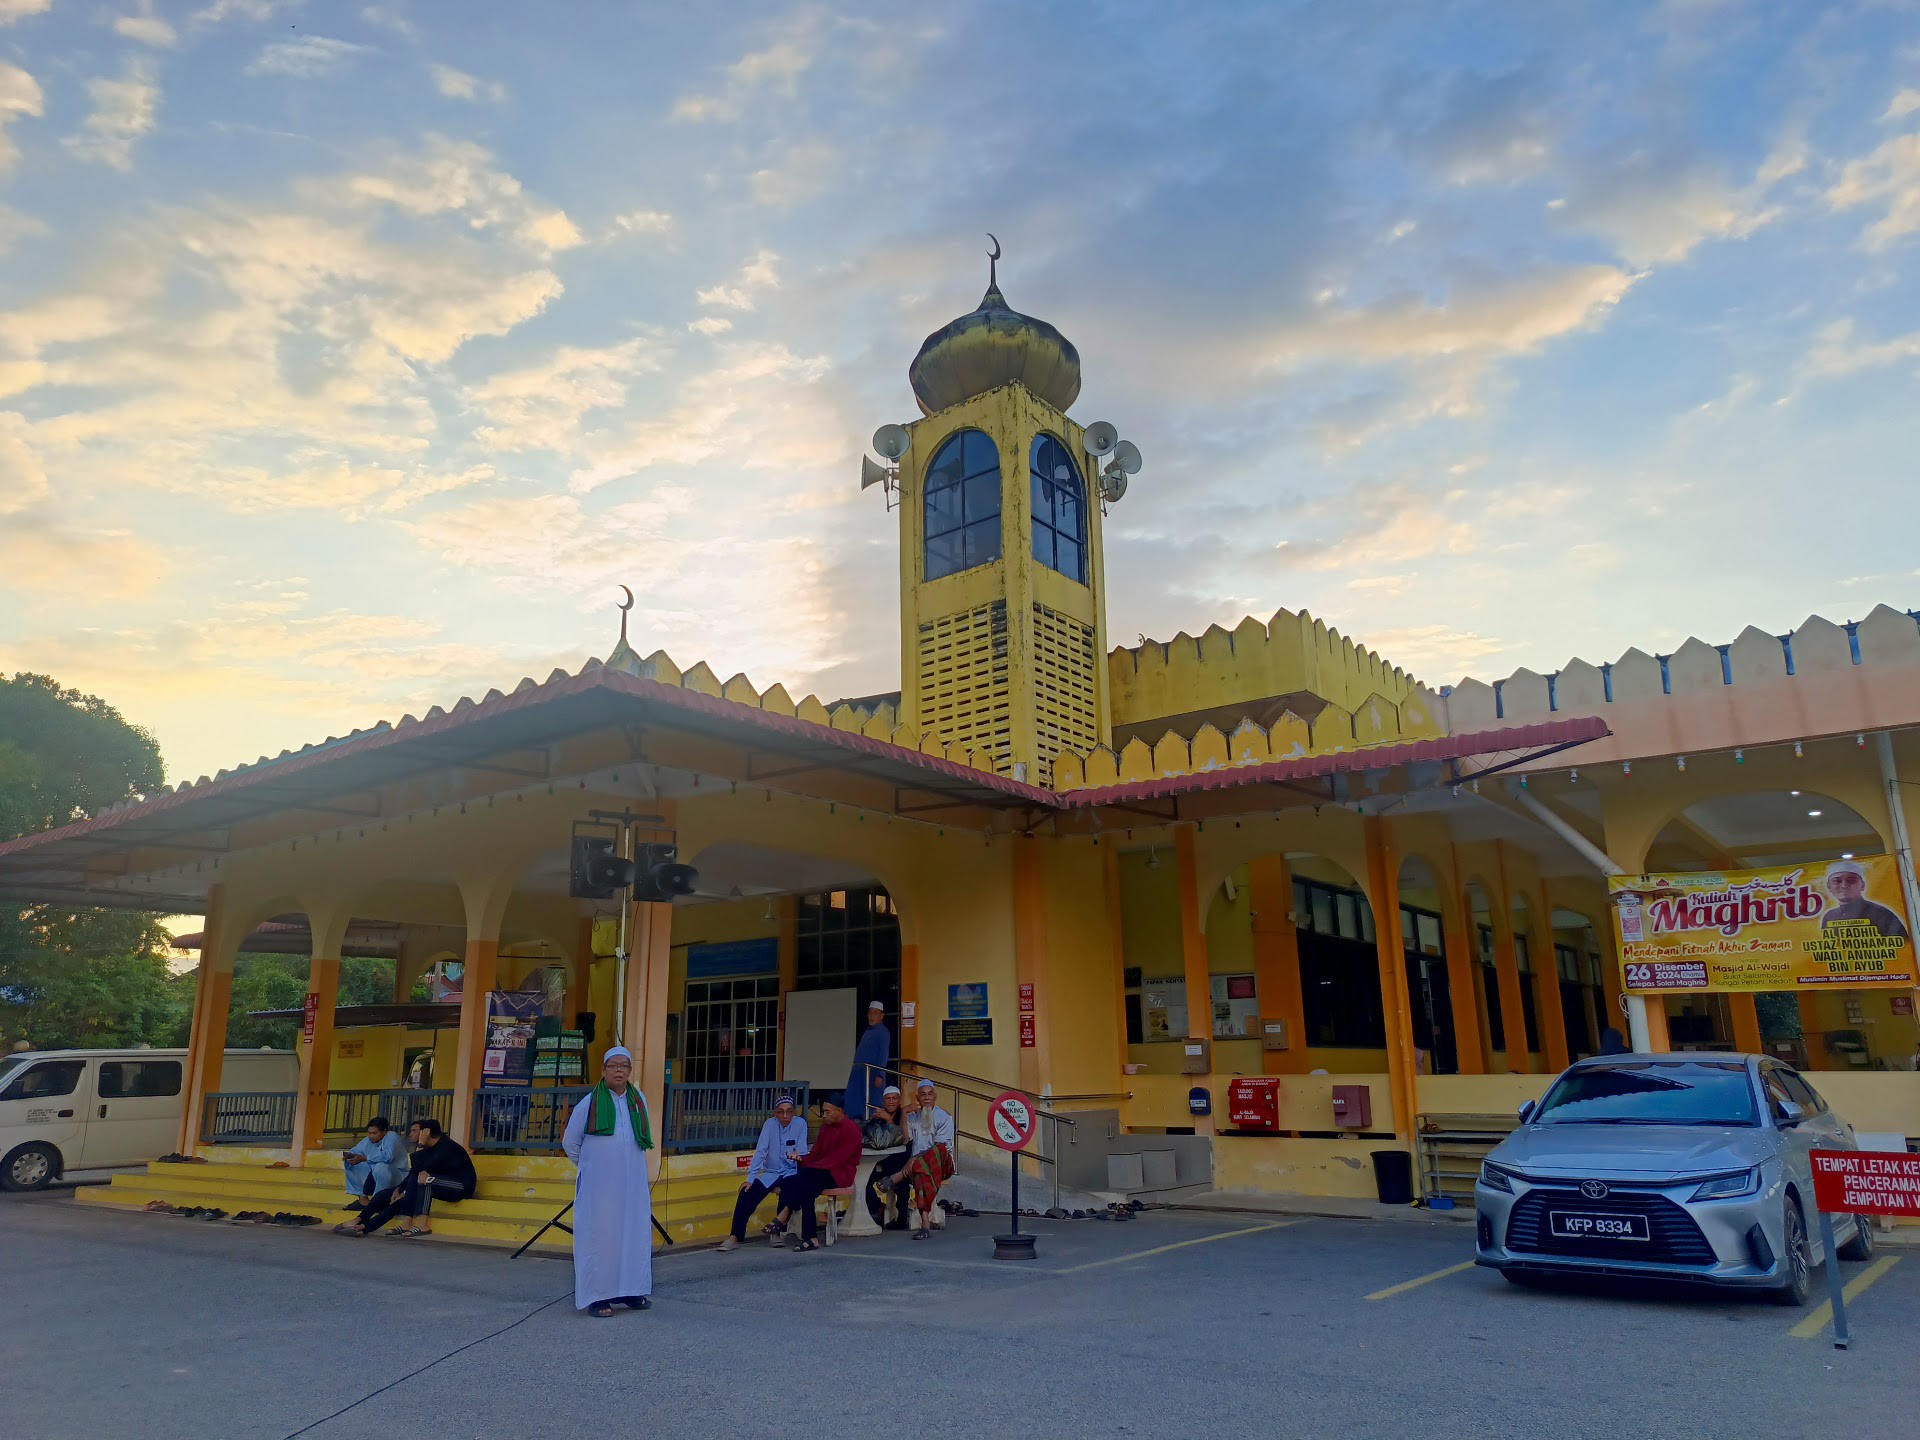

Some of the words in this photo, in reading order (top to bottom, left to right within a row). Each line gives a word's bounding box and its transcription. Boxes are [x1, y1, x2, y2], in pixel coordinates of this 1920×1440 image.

[1689, 891, 1737, 905] Kuliah
[1649, 886, 1822, 935] Maghrib
[1823, 929, 1835, 940] AL
[1840, 927, 1879, 939] FADHIL
[1624, 945, 1679, 958] Mendepani
[1682, 942, 1715, 955] Fitnah
[1719, 940, 1746, 952] Akhir
[1750, 939, 1790, 950] Zaman
[1802, 941, 1837, 952] USTAZ
[1841, 937, 1904, 950] MOHAMAD
[1813, 951, 1842, 962] WADI
[1848, 949, 1896, 961] ANNUAR
[1626, 964, 1651, 981] 26
[1654, 962, 1704, 972] Disember
[1712, 965, 1743, 973] Masjid
[1747, 963, 1790, 972] Al-Wajdi
[1829, 962, 1848, 972] BIN
[1854, 960, 1884, 972] AYUB
[1655, 971, 1681, 980] 2024
[1627, 980, 1655, 988] Selepas
[1676, 979, 1706, 987] Maghrib
[1815, 1157, 1860, 1173] TEMPAT
[1862, 1159, 1901, 1175] LETAK
[1903, 1160, 1920, 1176] KE
[1843, 1190, 1905, 1208] JEMPUTAN
[1565, 1217, 1593, 1232] KFP
[1595, 1219, 1633, 1234] 8334
